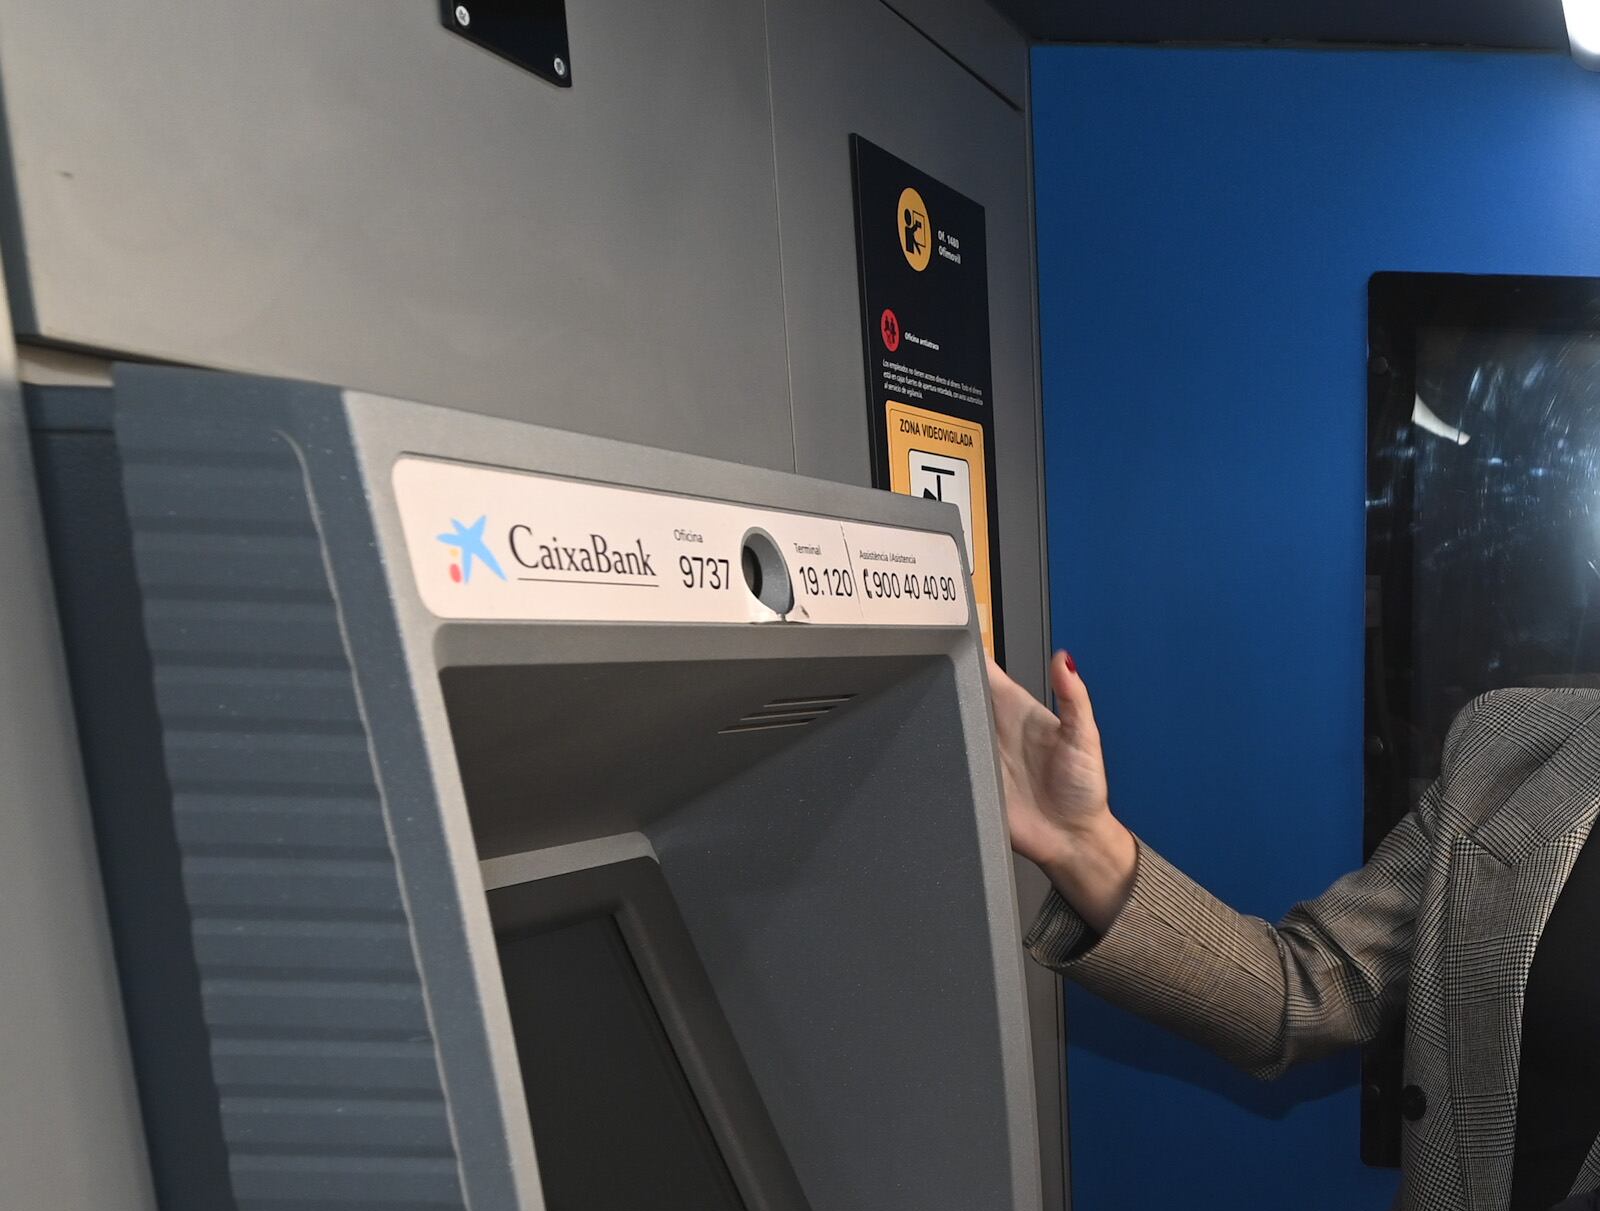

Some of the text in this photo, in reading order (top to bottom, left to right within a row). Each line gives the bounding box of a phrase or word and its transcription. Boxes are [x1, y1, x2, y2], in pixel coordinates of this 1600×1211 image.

[899, 418, 974, 448] ZONA VIDEOVIGILADA
[508, 524, 657, 577] CaixaBank
[673, 529, 704, 544] Oficina
[793, 543, 822, 556] Terminal
[679, 555, 730, 590] 9737
[799, 566, 853, 597] 19.120
[873, 571, 956, 601] 900 40 40 90
